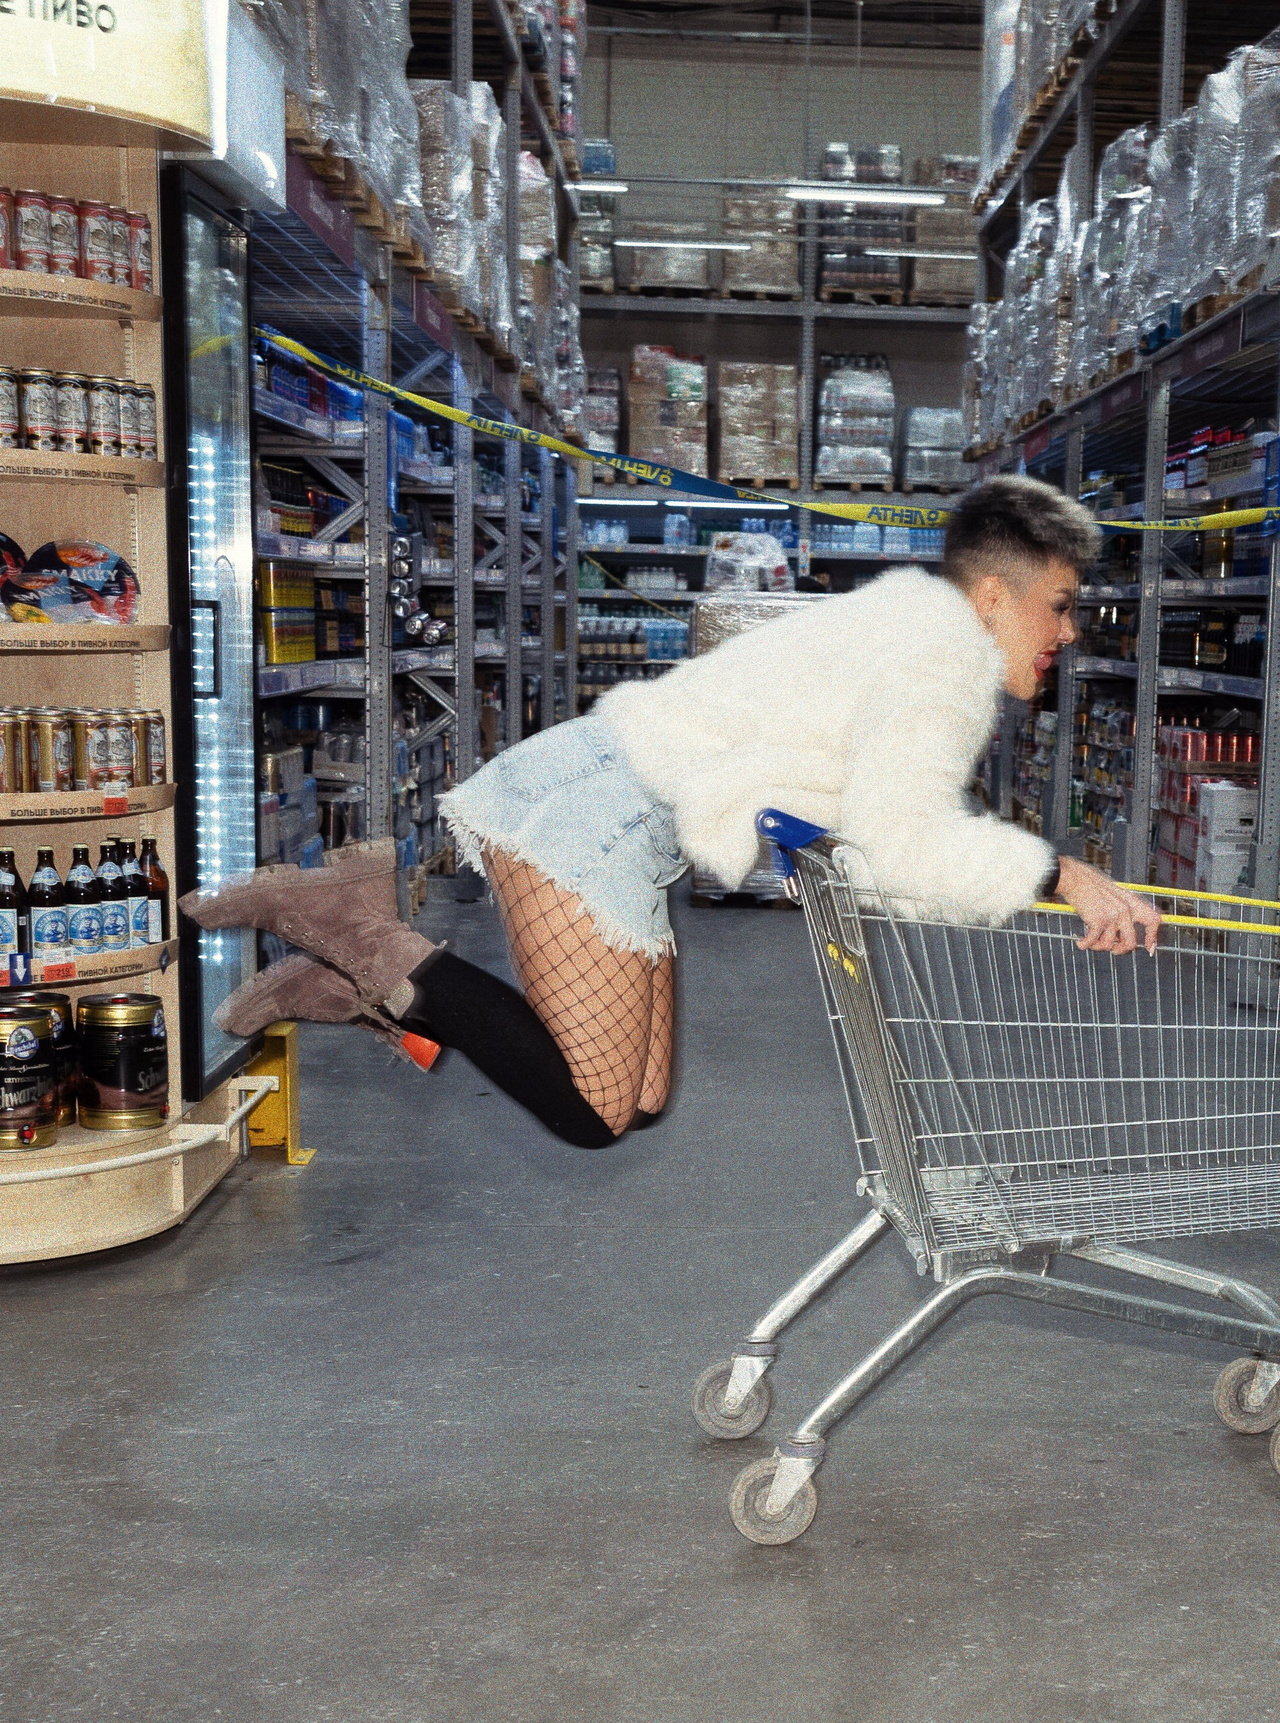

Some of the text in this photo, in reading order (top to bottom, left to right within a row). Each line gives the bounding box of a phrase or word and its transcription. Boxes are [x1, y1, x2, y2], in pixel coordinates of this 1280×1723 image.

[40, 639, 69, 648] ВЫБОР
[78, 639, 107, 648] ПИВНОЙ
[10, 808, 48, 818] БОЛЬШЕ
[50, 807, 79, 817] ВЫБОР
[78, 966, 108, 978] ПИВНОЙ
